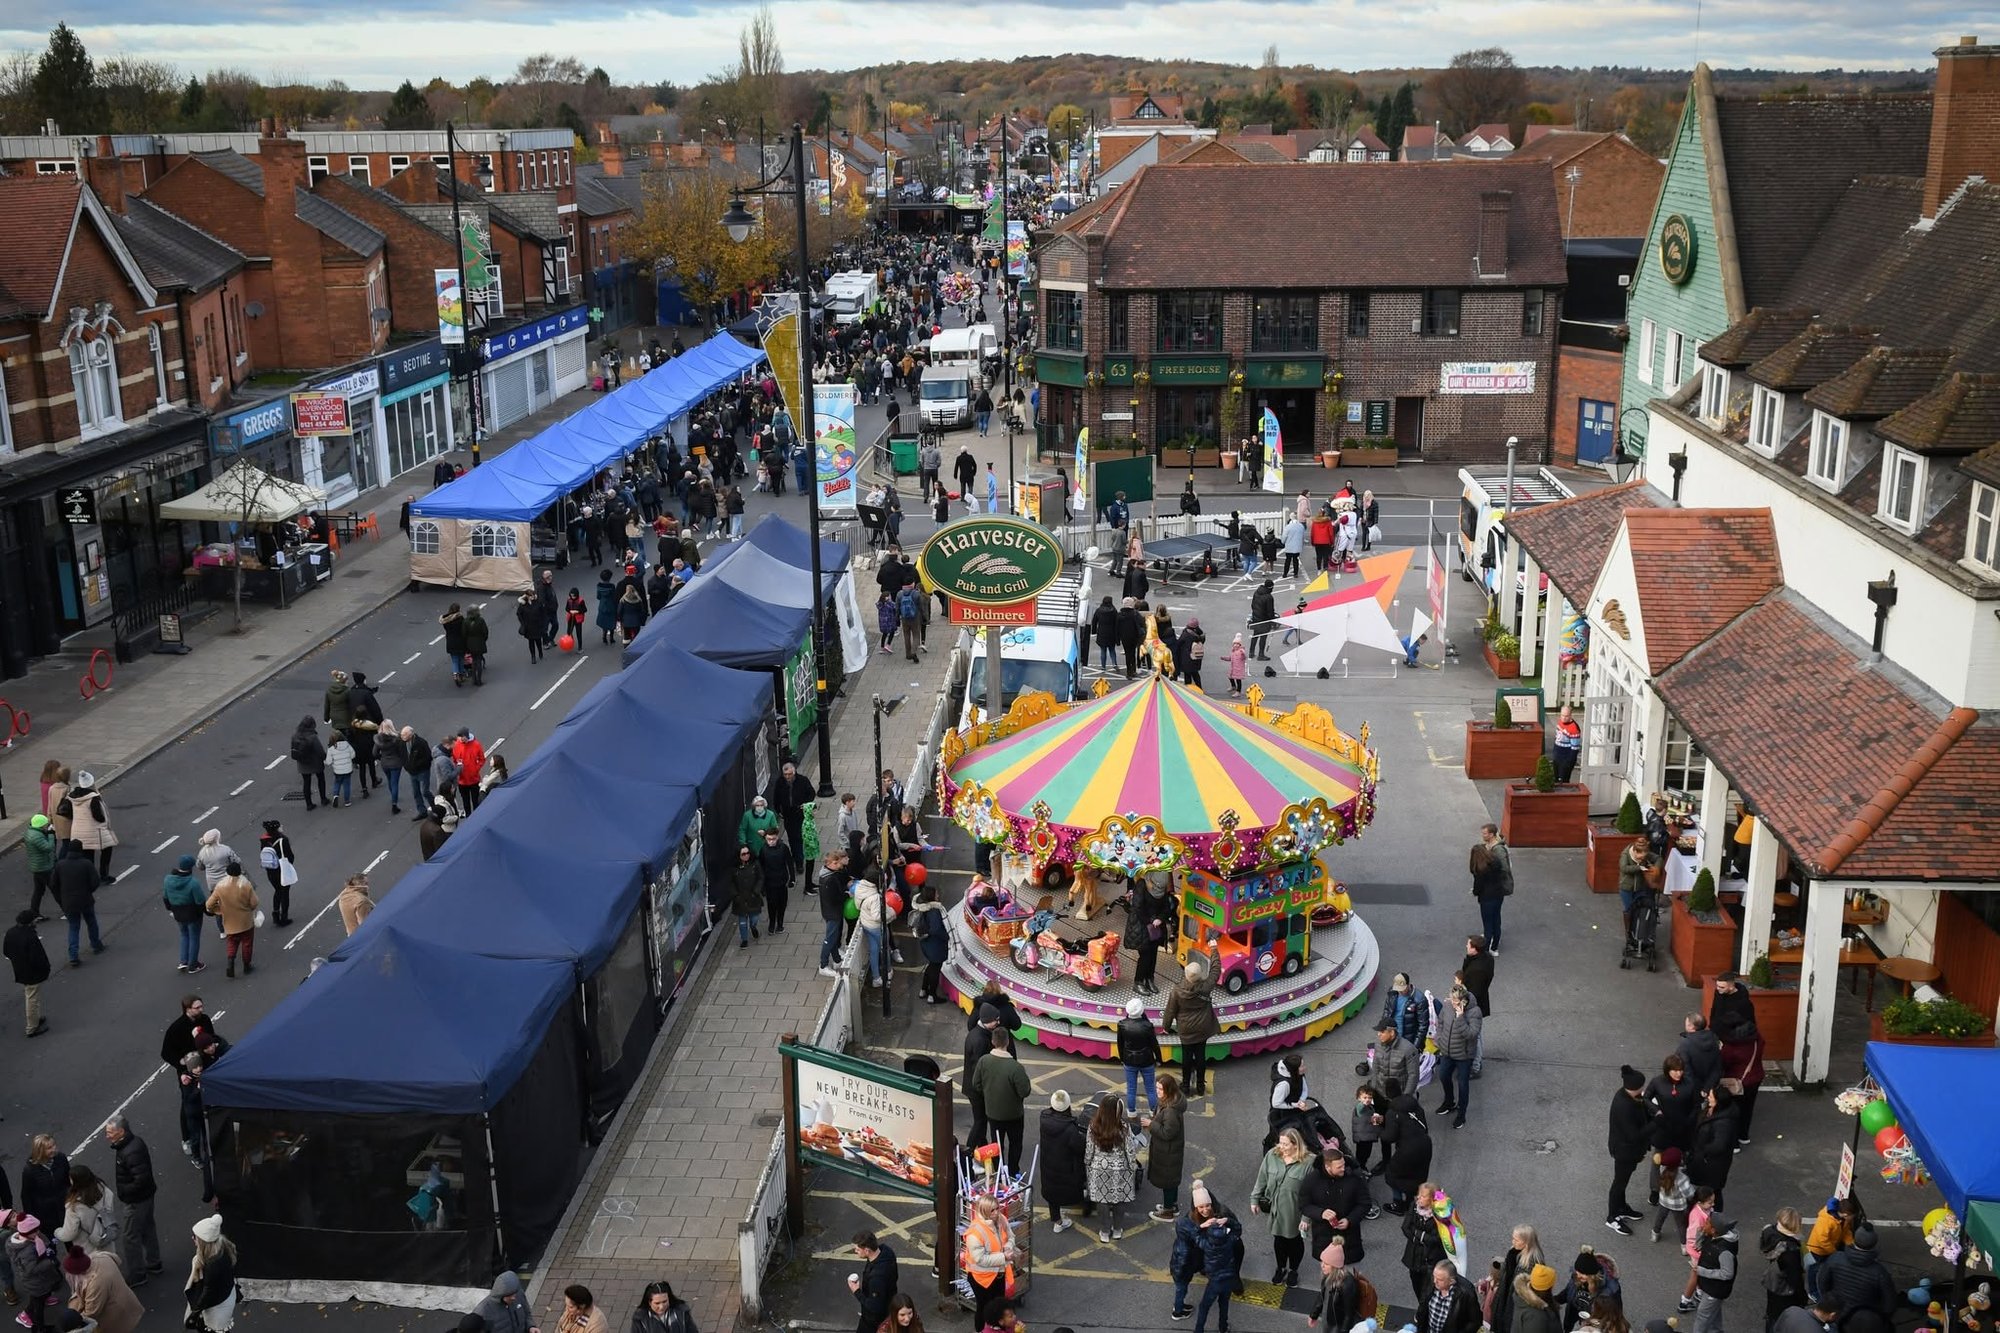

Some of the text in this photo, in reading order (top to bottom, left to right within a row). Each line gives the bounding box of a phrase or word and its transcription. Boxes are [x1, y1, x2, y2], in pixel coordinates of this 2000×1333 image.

[402, 352, 431, 372] BEDTIME
[1111, 364, 1127, 376] 63
[1160, 365, 1221, 374] FREE HOUSE
[359, 374, 370, 386] SON
[1450, 376, 1526, 387] OUR GARDEN IS OPEN
[244, 407, 282, 437] GREGGS
[937, 529, 1046, 558] Harvester
[955, 578, 1029, 594] Pub and Grill
[962, 608, 1025, 620] Boldmere
[1512, 699, 1528, 707] EPIC
[1234, 888, 1320, 922] Crazy Bus
[842, 1076, 888, 1099] TRY OUR
[816, 1081, 915, 1120] NEW BREAKFASTS
[849, 1108, 867, 1119] From
